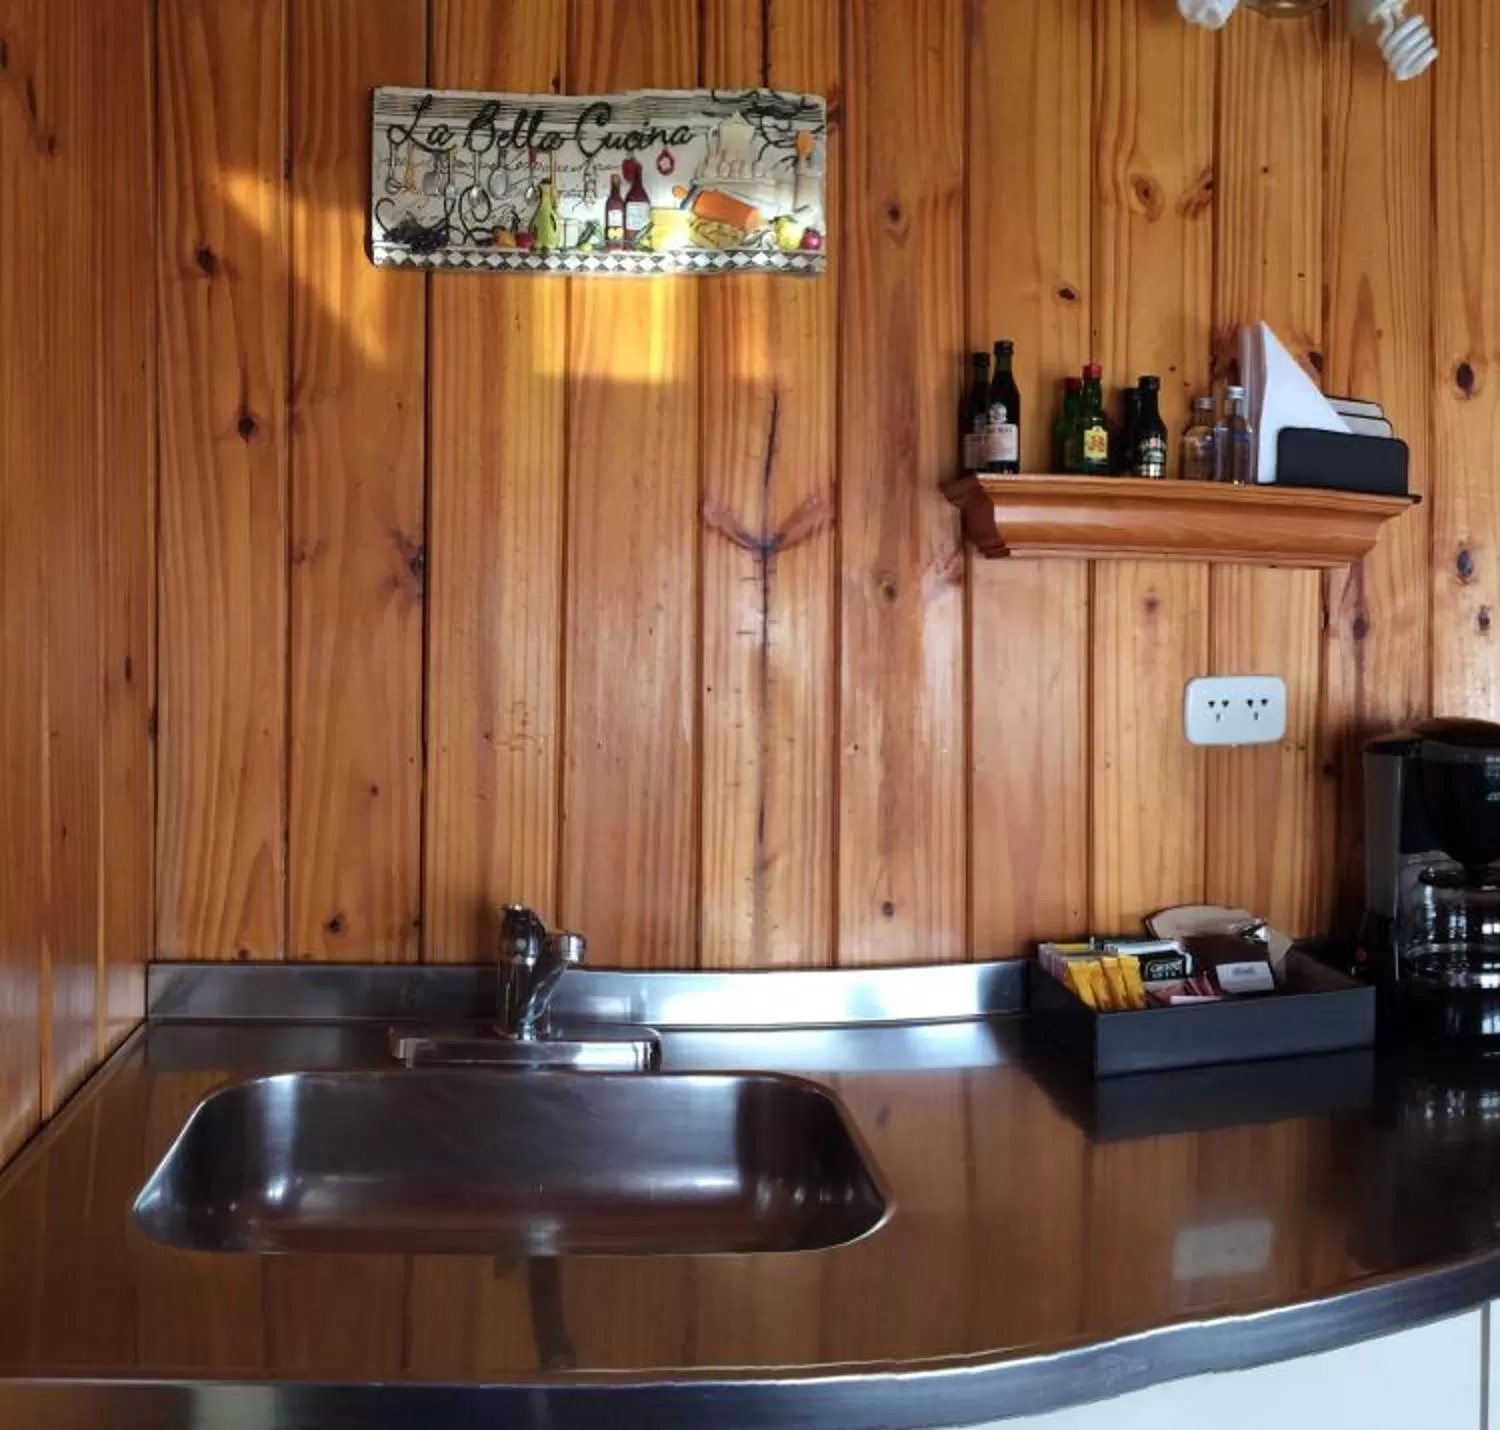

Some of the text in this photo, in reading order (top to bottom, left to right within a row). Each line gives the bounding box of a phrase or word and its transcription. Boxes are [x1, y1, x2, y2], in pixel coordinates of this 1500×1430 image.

[387, 94, 694, 157] La Bella Cucina
